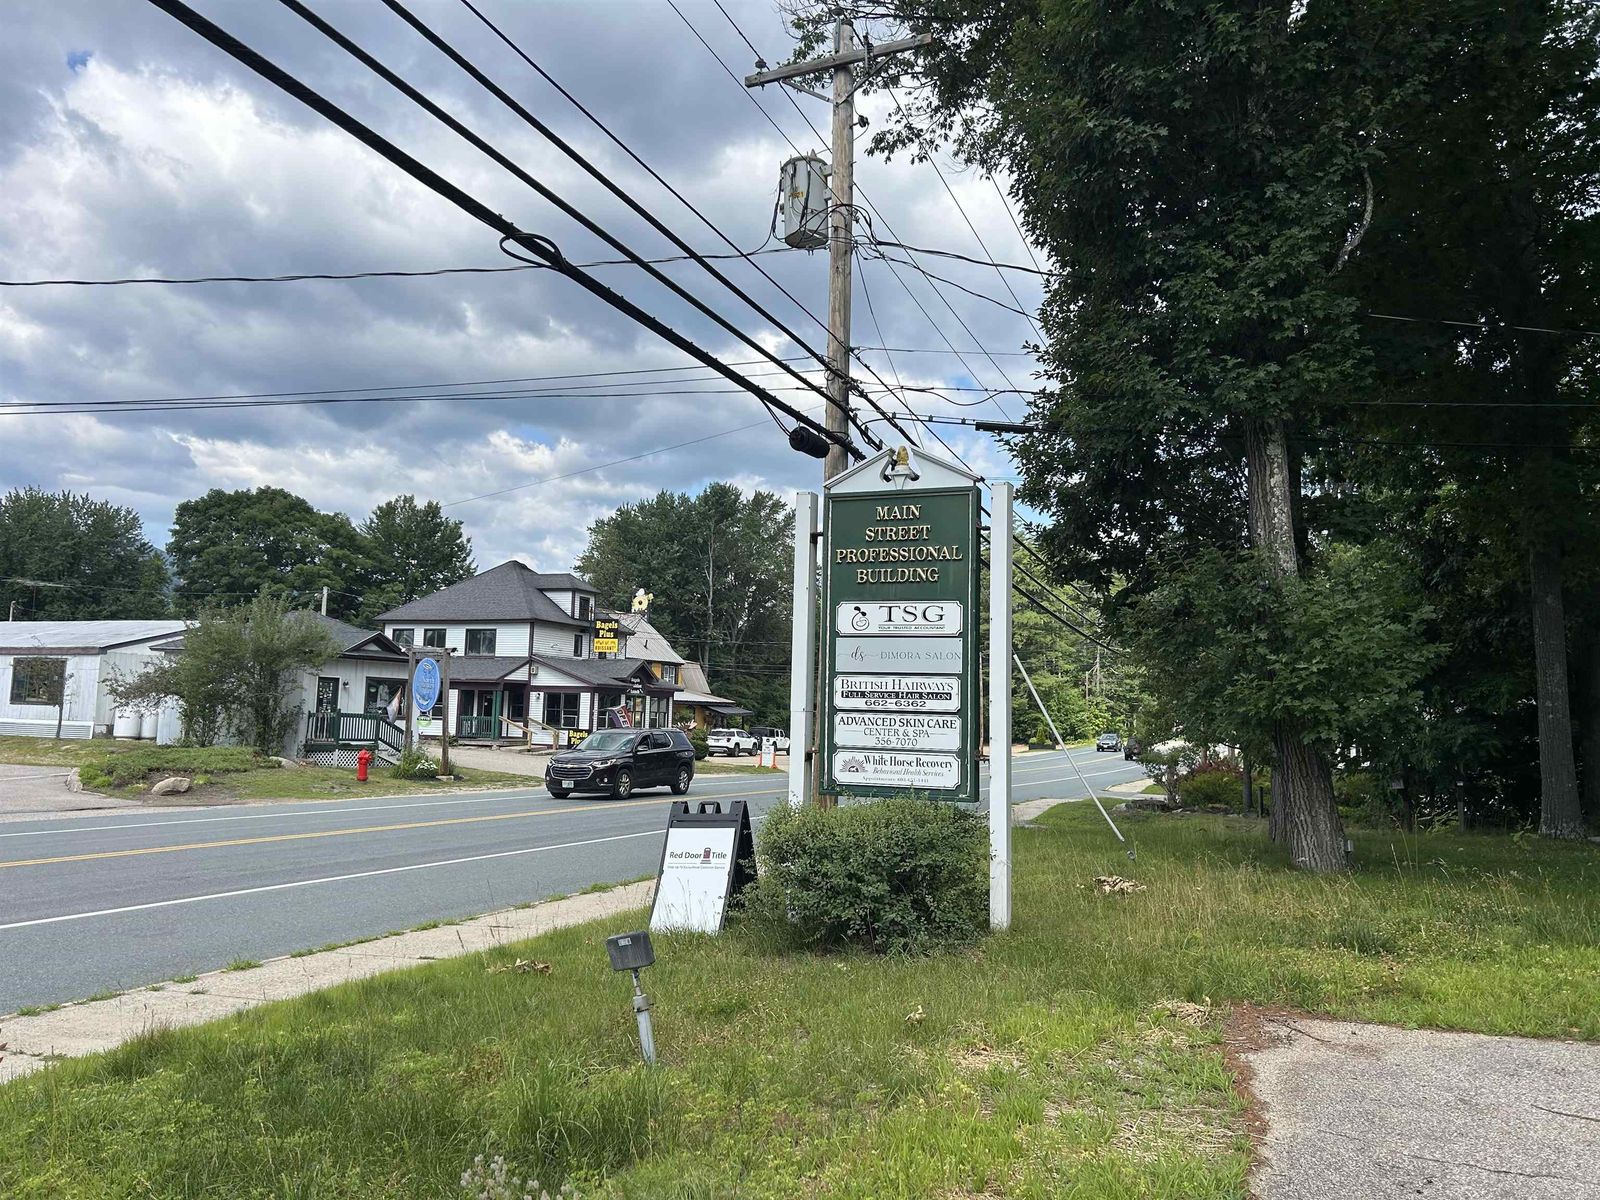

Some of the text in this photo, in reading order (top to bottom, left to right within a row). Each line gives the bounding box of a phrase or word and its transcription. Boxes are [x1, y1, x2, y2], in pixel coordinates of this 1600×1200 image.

[876, 505, 921, 520] MAIN
[865, 525, 931, 541] STREET
[836, 545, 963, 563] PROFESSIONAL
[856, 567, 940, 583] BUILDING
[879, 605, 945, 623] TSG
[596, 620, 618, 630] Bagels
[599, 630, 614, 638] Plus
[880, 651, 921, 660] DIMORA
[925, 652, 961, 661] SALON
[841, 679, 954, 691] BRITISH HAIRWAYS
[864, 691, 897, 699] SERVICE
[898, 691, 920, 700] HAIR
[922, 692, 951, 700] SALON
[838, 716, 957, 729] ADVANCED SKIN CARE
[569, 730, 588, 738] Bagels
[863, 728, 930, 738] CENTER & SPA
[874, 737, 918, 746] 356-7070
[863, 755, 953, 769] White Horse Recovery
[902, 768, 922, 776] Health
[922, 769, 945, 777] Services
[669, 851, 727, 859] Red Door Title
